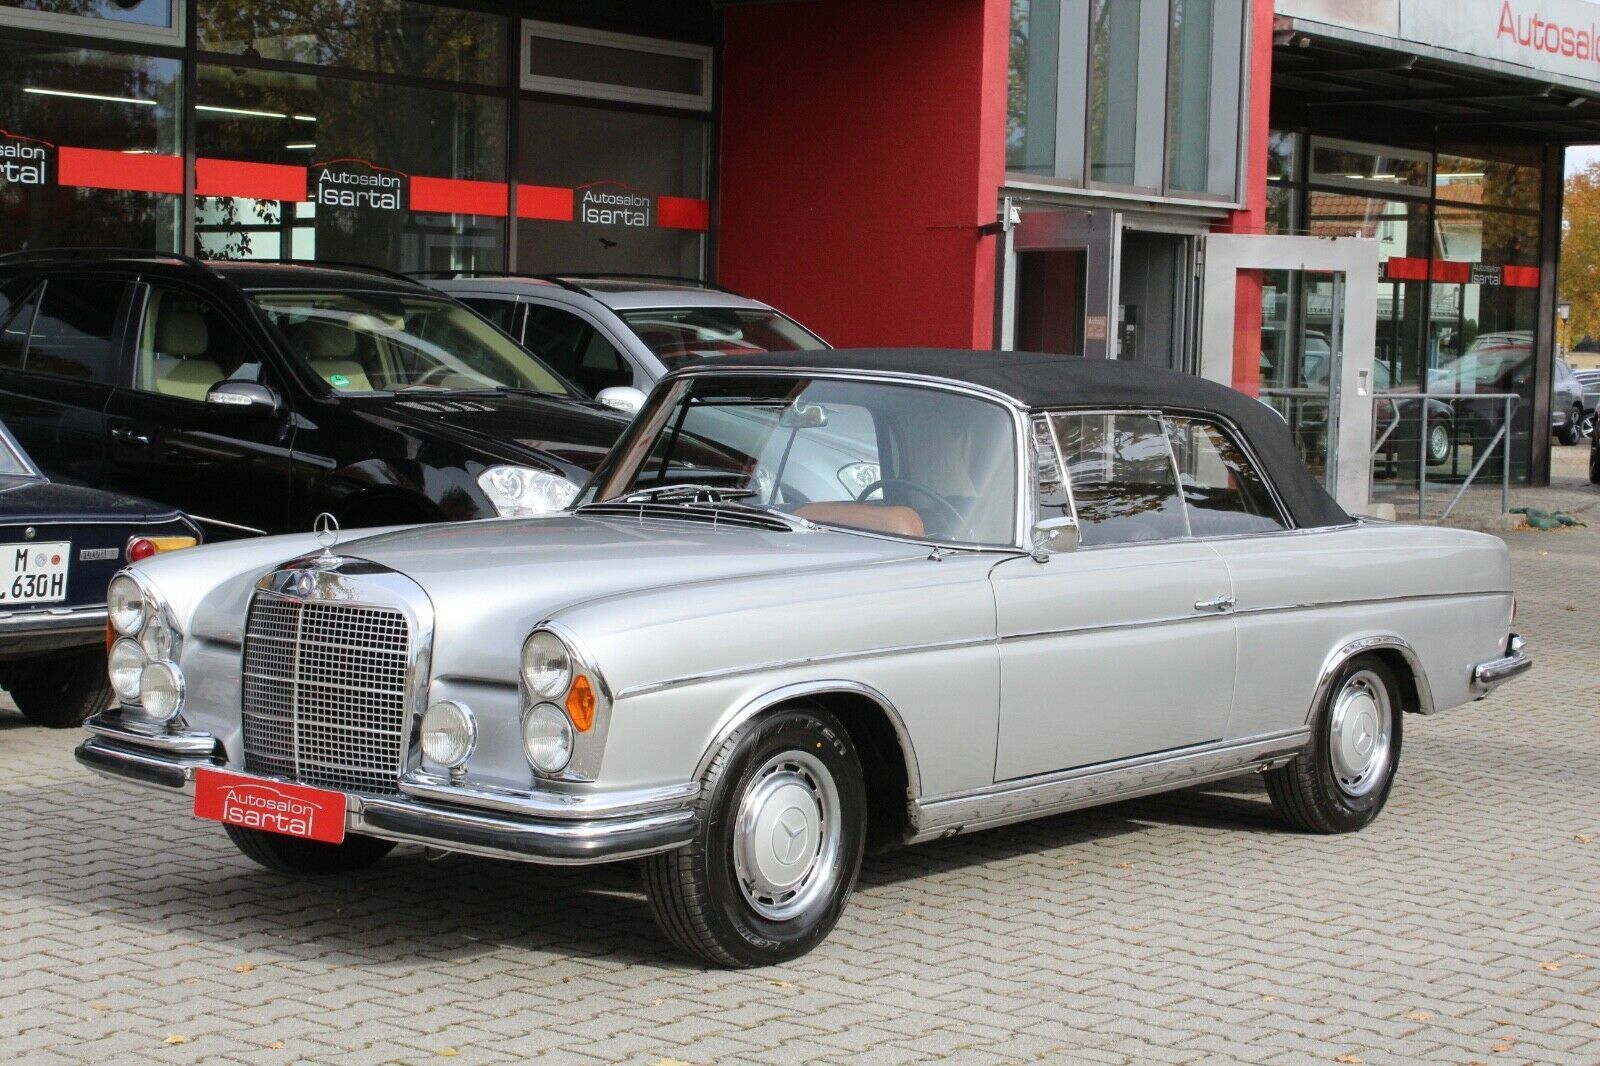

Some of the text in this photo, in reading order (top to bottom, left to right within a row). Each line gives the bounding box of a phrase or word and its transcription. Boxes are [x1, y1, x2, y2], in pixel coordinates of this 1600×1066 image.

[319, 168, 401, 188] Autosalon
[318, 182, 400, 210] Isartal
[582, 190, 650, 207] Autosalon
[582, 203, 650, 227] Isartal
[15, 549, 28, 572] M
[225, 789, 314, 818] Autosalon
[223, 800, 313, 836] Isartal
